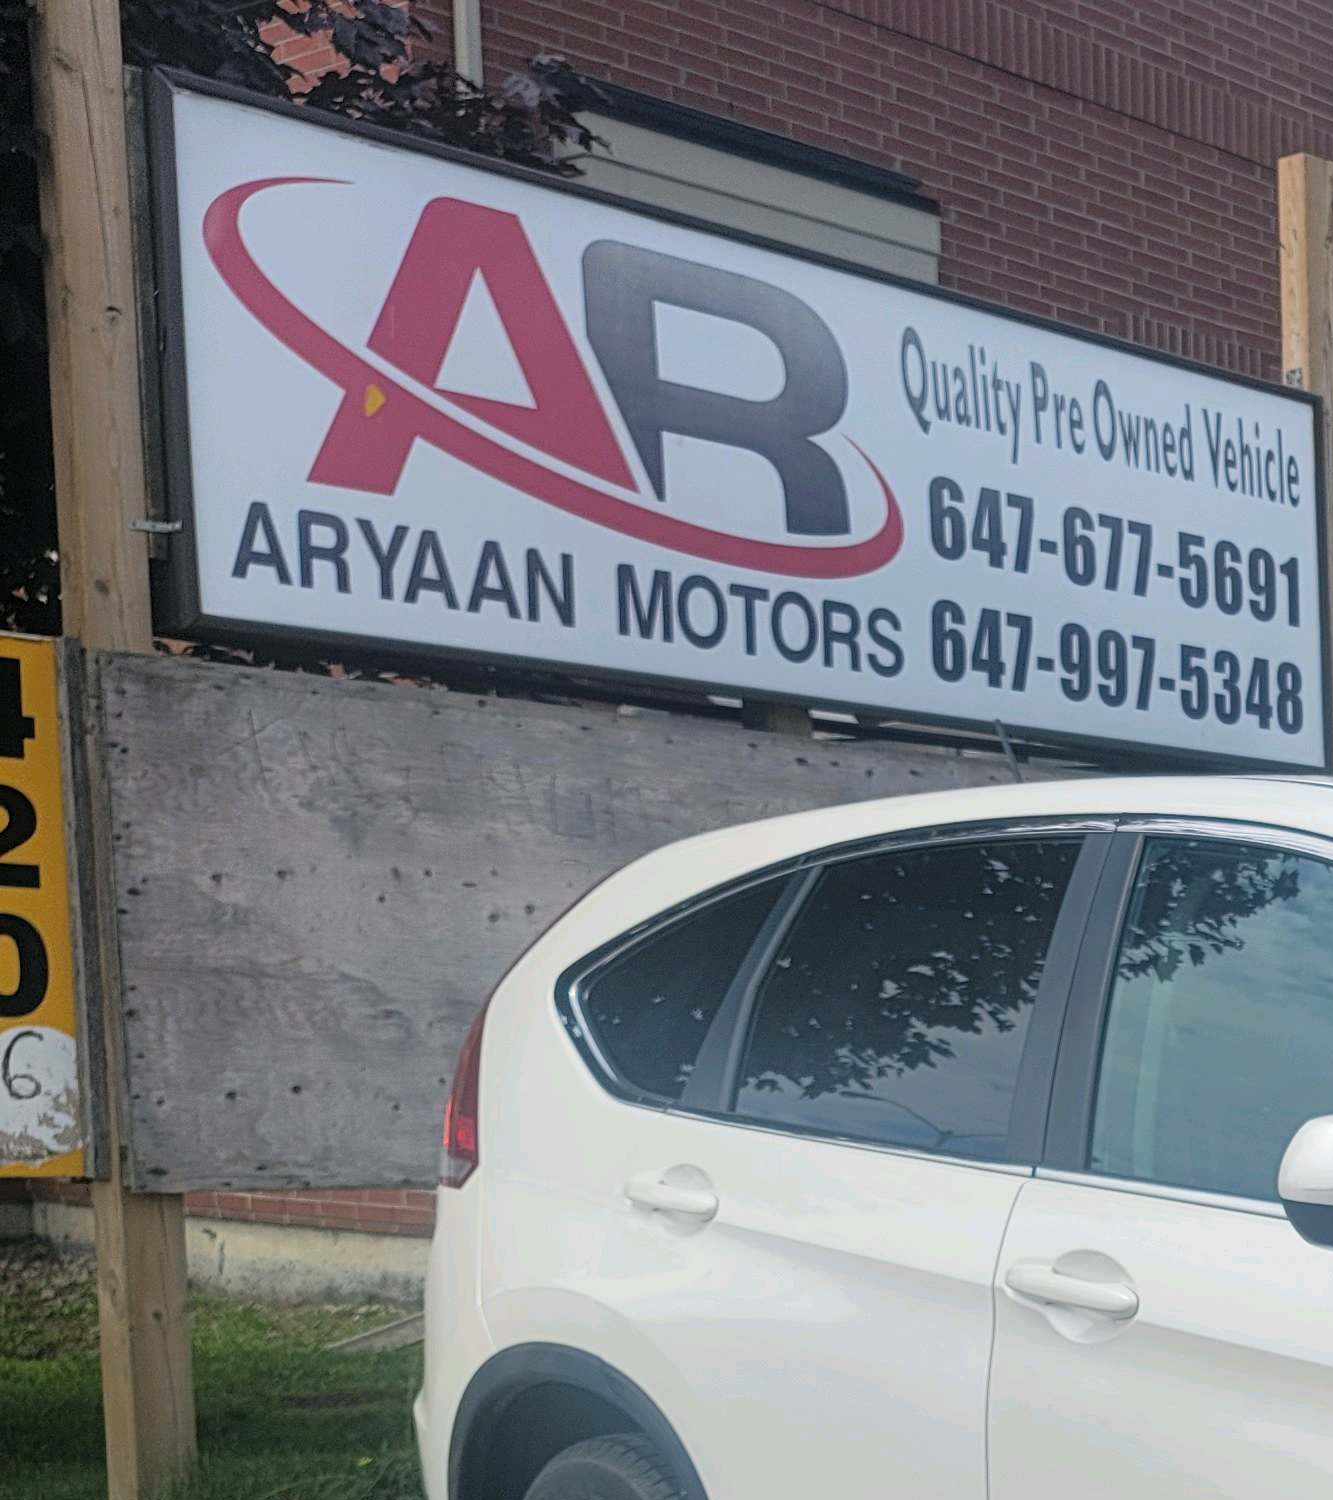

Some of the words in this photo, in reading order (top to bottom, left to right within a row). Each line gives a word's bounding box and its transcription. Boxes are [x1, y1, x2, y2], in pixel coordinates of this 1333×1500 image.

[900, 325, 1022, 464] Quality
[1030, 360, 1086, 455] Pre
[1092, 379, 1195, 481] Owned
[1202, 407, 1301, 508] Vehicle
[231, 501, 576, 627] ARYAAN
[617, 563, 905, 678] MOTORS
[928, 475, 1301, 628] 647-677-5691
[930, 598, 1304, 735] 647-997-5348
